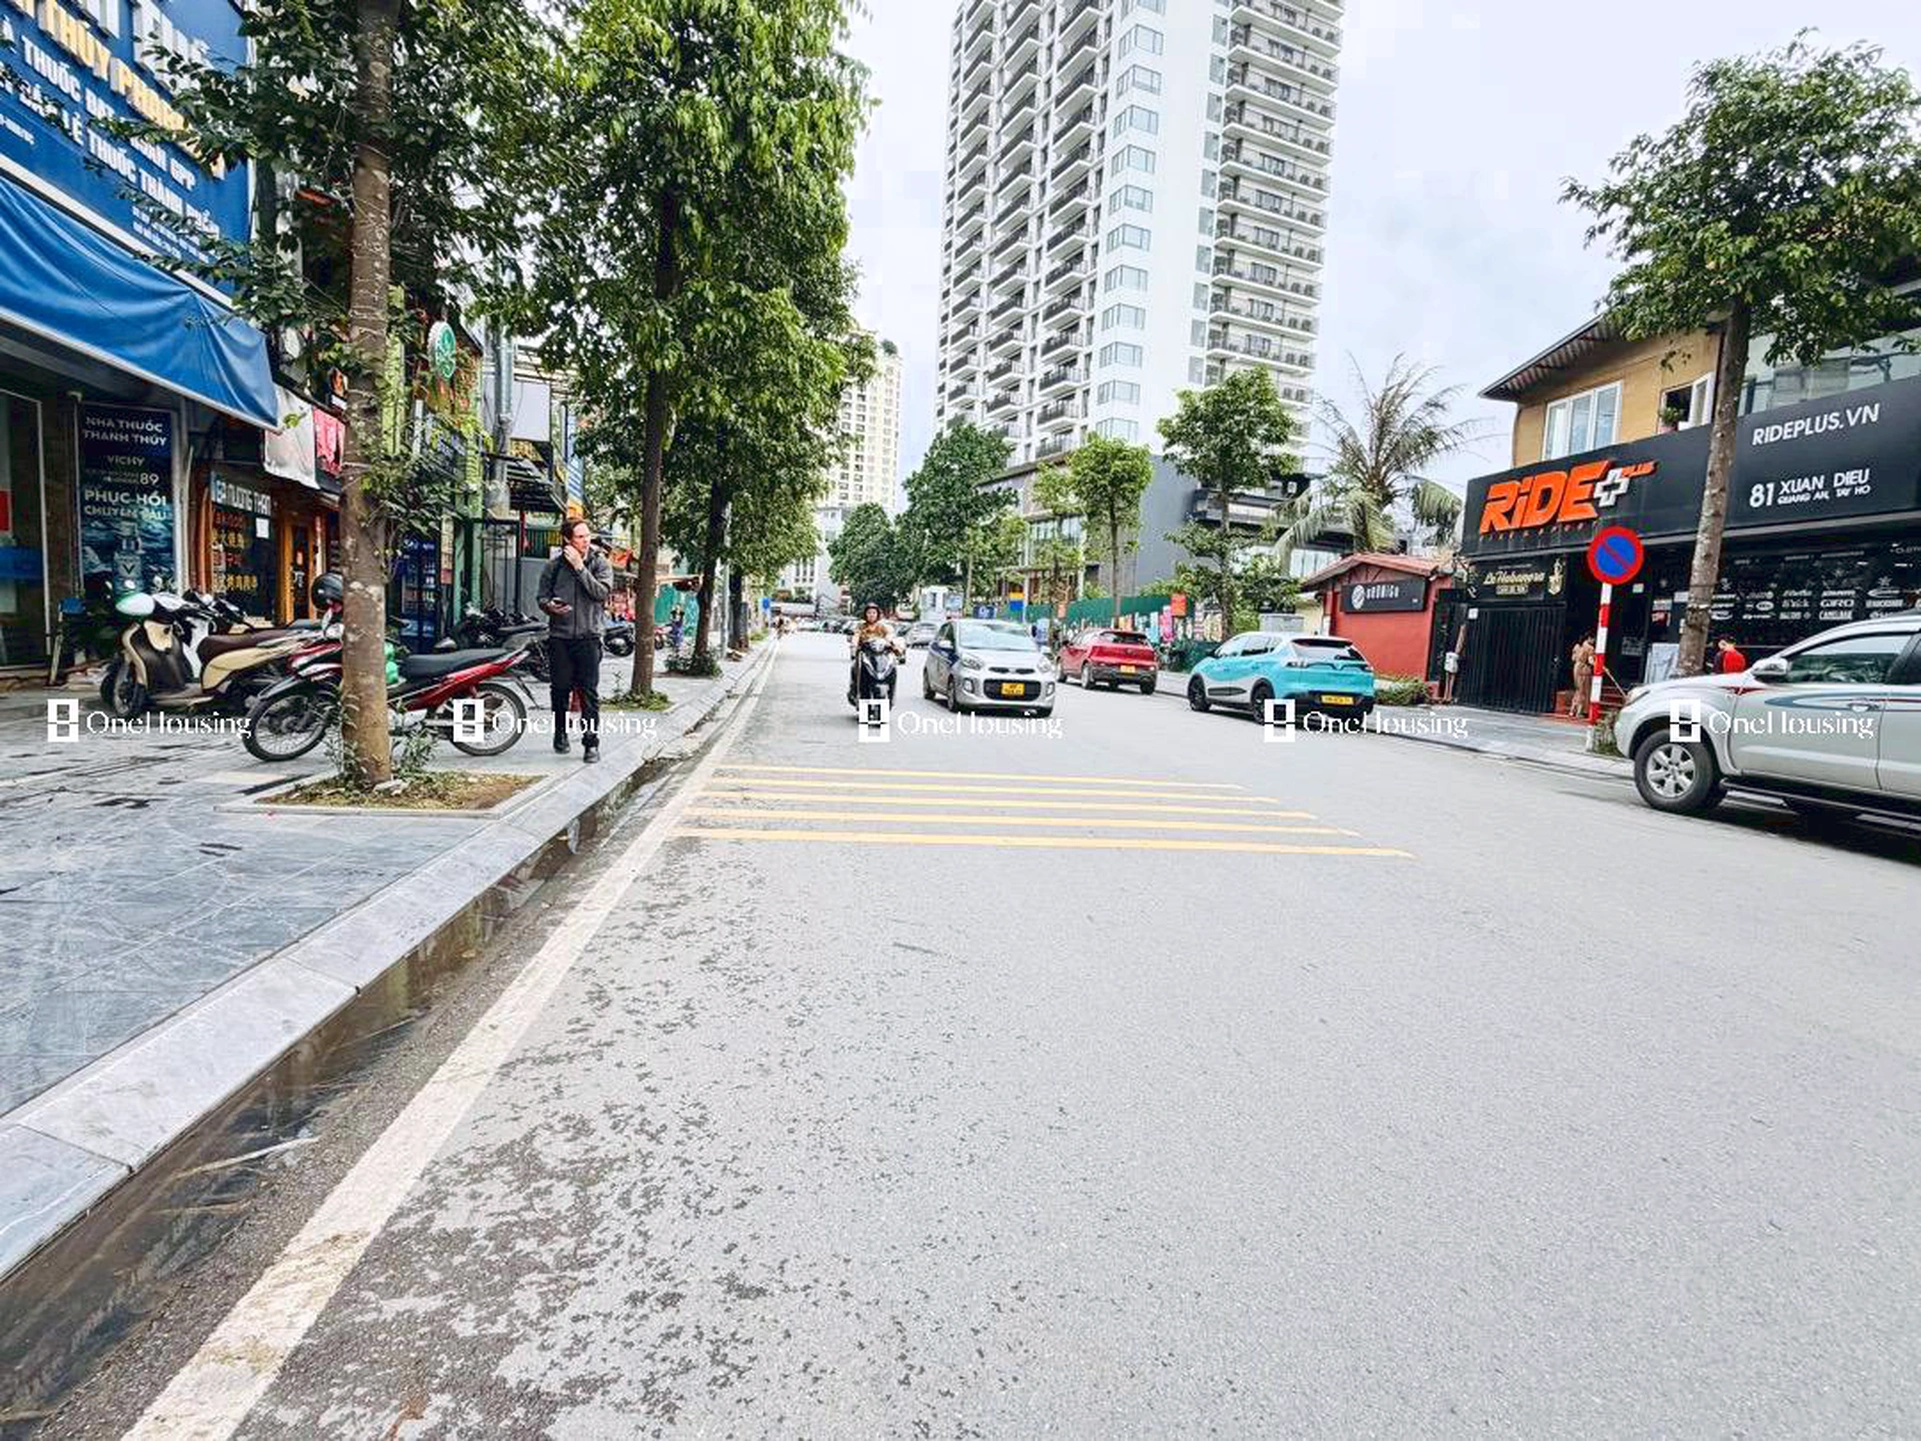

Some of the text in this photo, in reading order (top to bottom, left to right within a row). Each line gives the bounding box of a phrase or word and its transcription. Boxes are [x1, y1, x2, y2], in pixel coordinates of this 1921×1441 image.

[1751, 403, 1880, 446] RIDEPLUS.VN
[140, 472, 159, 485] 89
[1748, 468, 1871, 508] 81 XUAN DIEU
